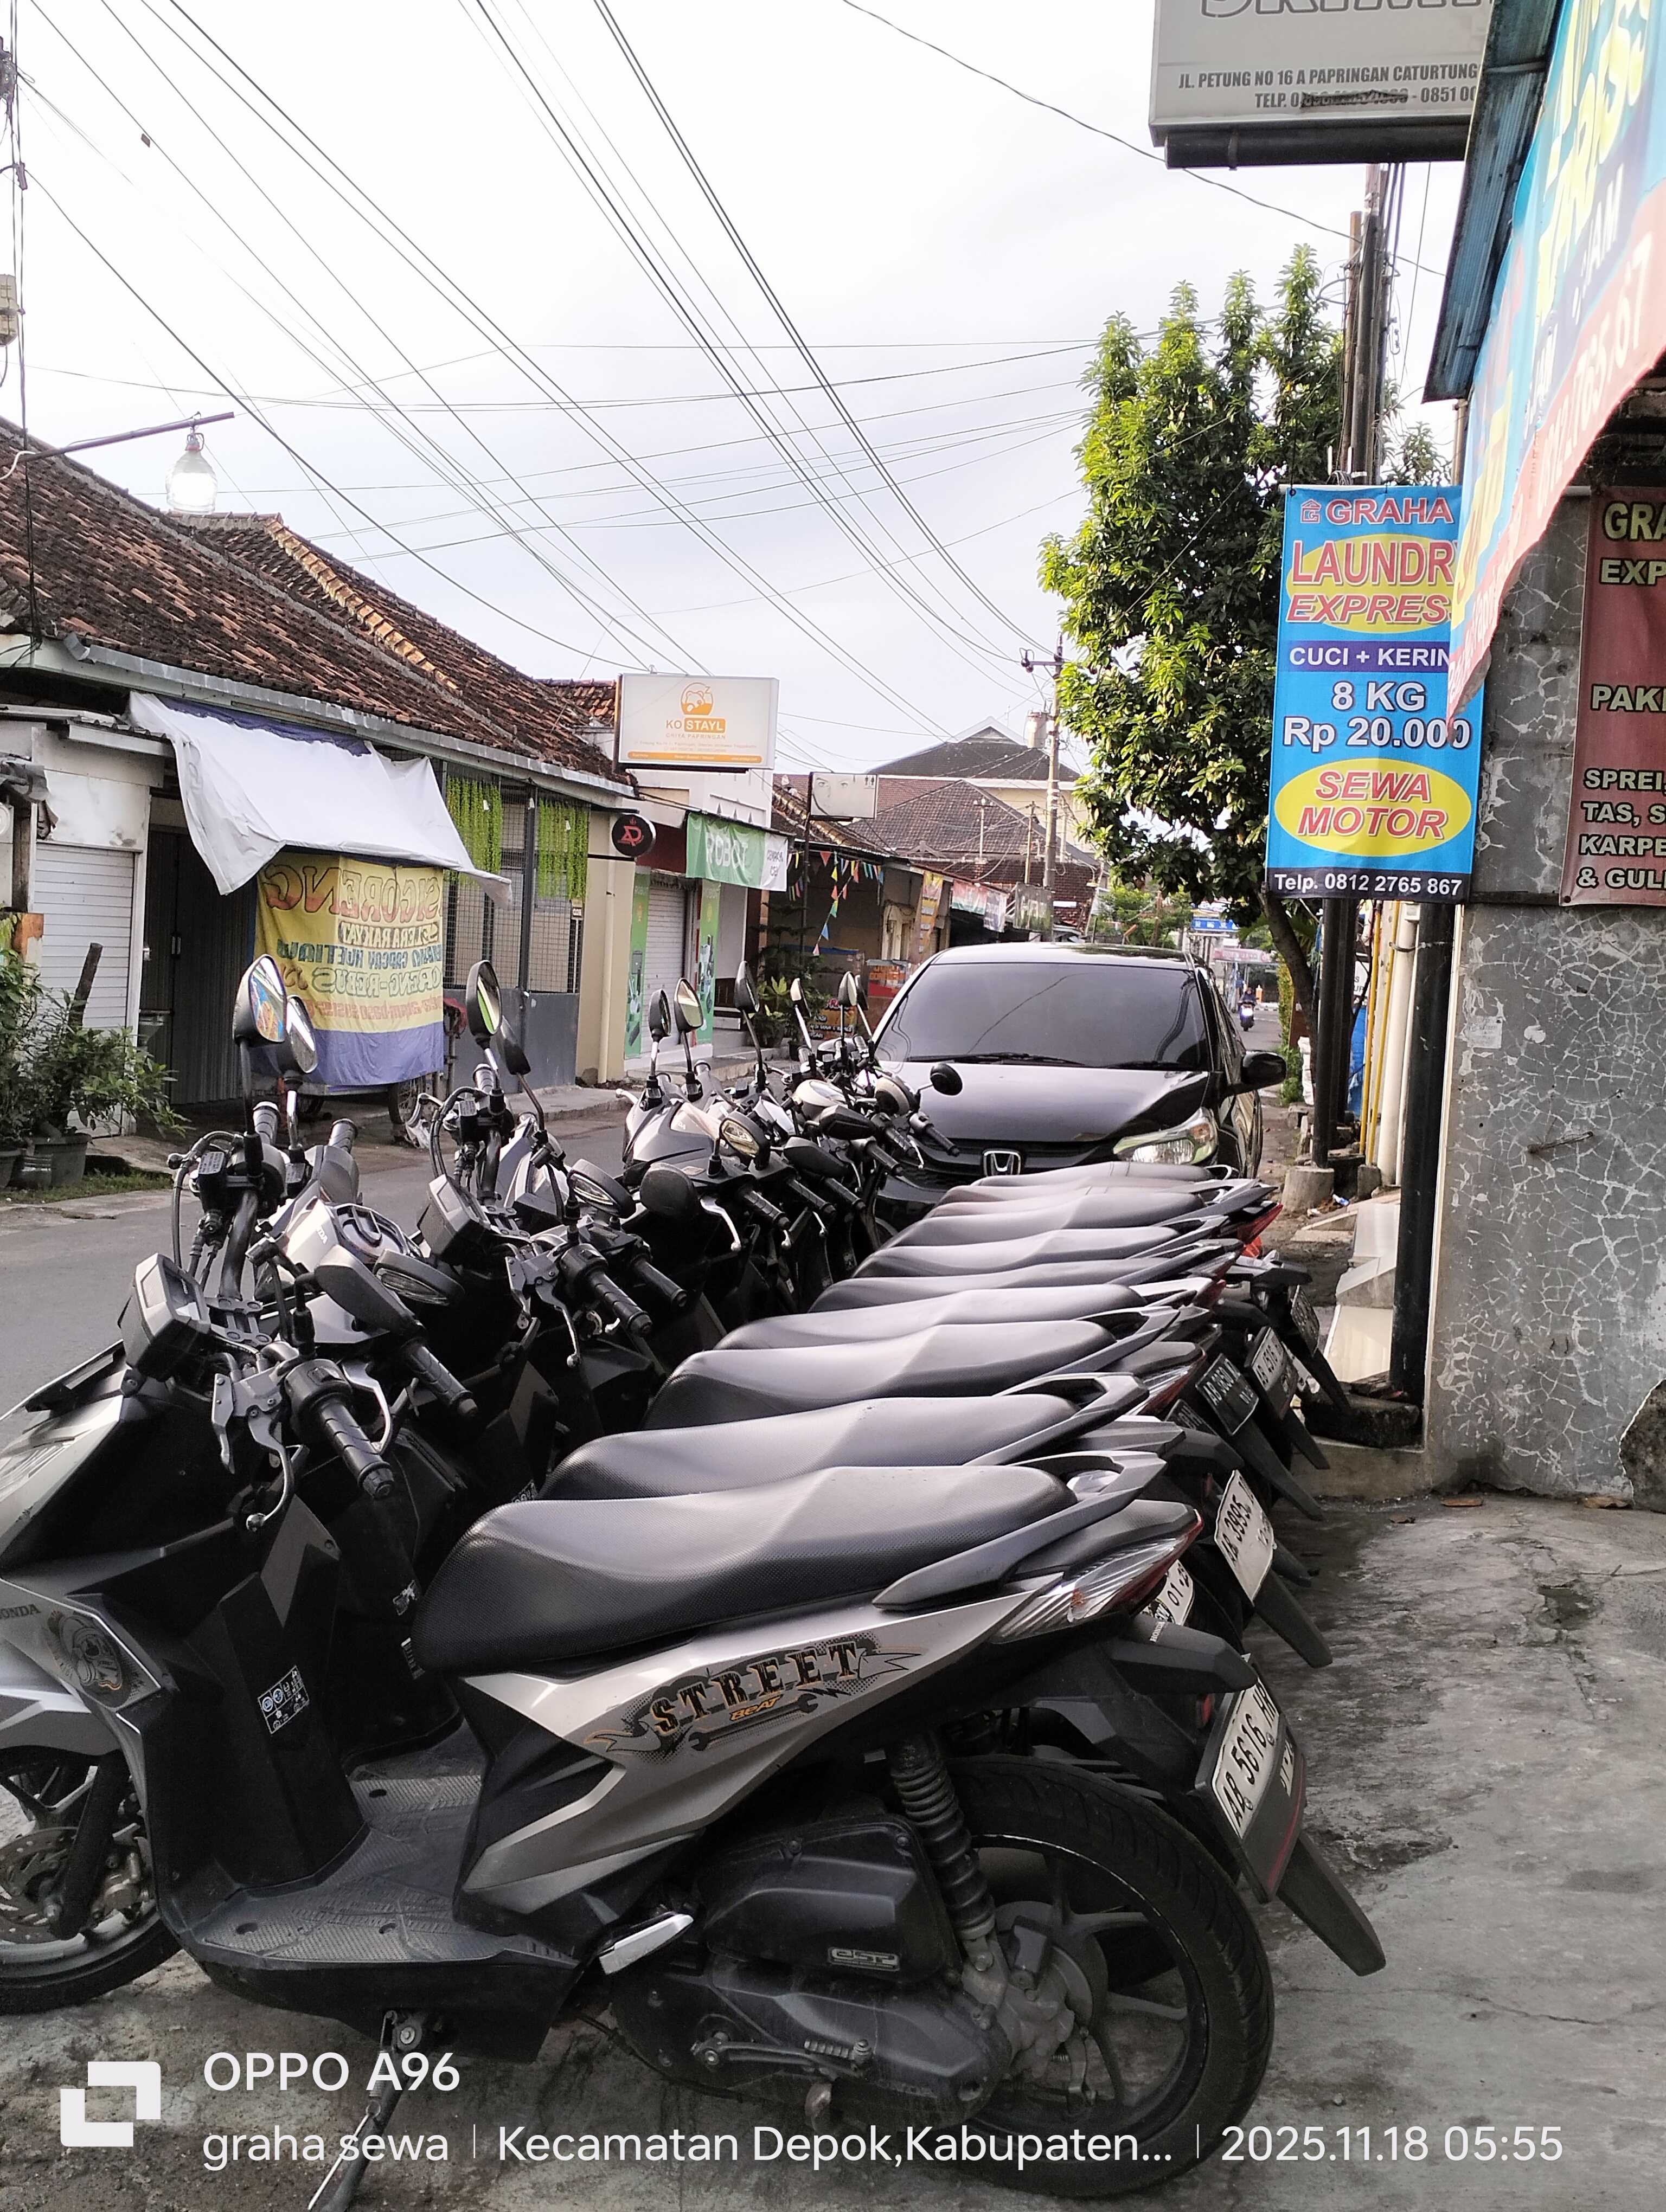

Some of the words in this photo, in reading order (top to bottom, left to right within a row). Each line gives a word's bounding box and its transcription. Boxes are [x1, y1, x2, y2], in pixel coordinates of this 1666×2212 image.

[1178, 73, 1194, 88] JL.
[1198, 70, 1251, 88] PETUNG
[1254, 70, 1273, 86] NO
[1277, 69, 1293, 85] 16
[1296, 69, 1306, 85] A
[1309, 66, 1389, 84] PAPRINGAN
[1393, 62, 1481, 81] CATURTUNG
[1255, 92, 1286, 108] TELP.
[1420, 86, 1457, 102] 0851
[1326, 497, 1453, 525] GRAHA
[1292, 540, 1458, 586] LAUNDR
[1286, 594, 1451, 625] EXPRES
[1290, 647, 1348, 666] CUCI
[1356, 651, 1368, 663] +
[1378, 648, 1450, 667] KERIN
[1332, 681, 1355, 711] 8
[1366, 681, 1427, 712] KG
[1591, 684, 1666, 712] PAK
[686, 720, 723, 731] STAYL
[1283, 717, 1336, 753] Rp
[1347, 717, 1471, 749] 20.000
[1315, 771, 1432, 803] SEWA
[1298, 806, 1448, 839] MOTOR
[1581, 801, 1642, 828] TAS,
[1274, 874, 1318, 892] Telp.
[1325, 873, 1369, 891] 0812
[1374, 877, 1421, 893] 2765
[1427, 878, 1462, 896] 867
[1576, 866, 1599, 889] &
[651, 1641, 858, 1734] STREET
[1231, 1713, 1267, 1785] 5616
[1222, 1771, 1246, 1829] AB
